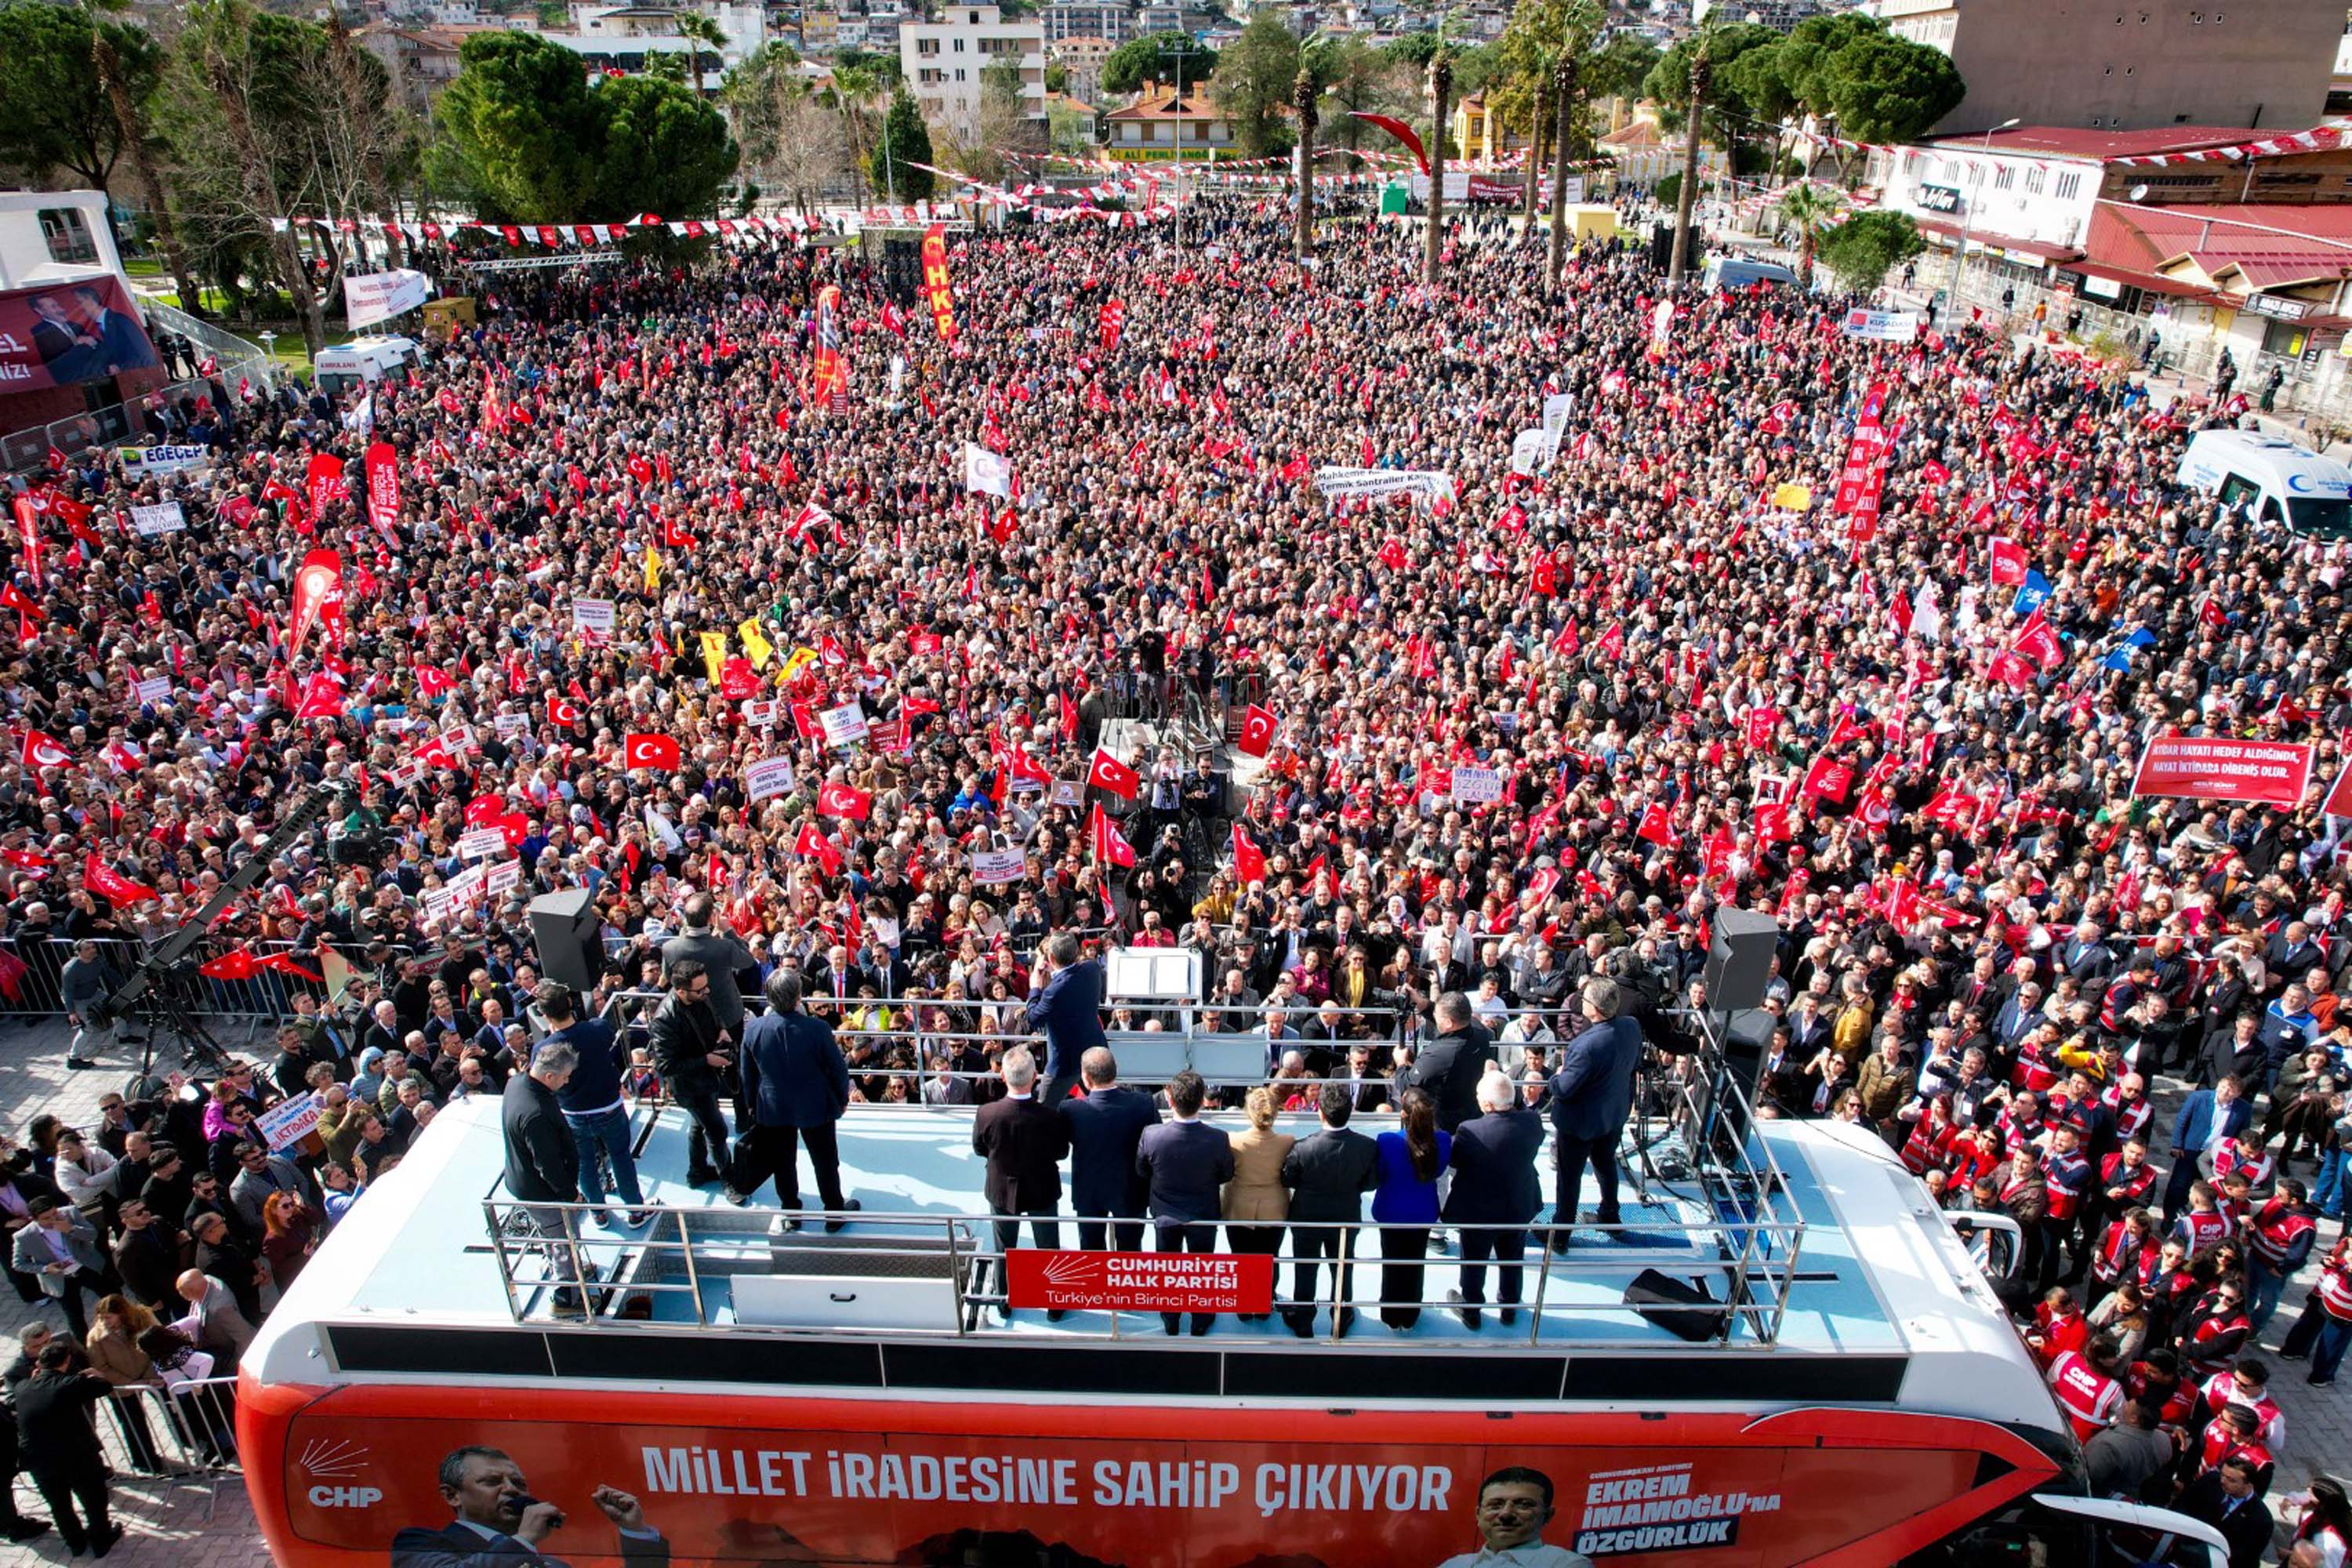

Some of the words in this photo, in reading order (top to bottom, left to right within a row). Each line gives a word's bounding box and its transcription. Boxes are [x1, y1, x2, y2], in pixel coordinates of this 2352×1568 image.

[1320, 481, 1354, 492] Termik
[1356, 475, 1405, 488] Santraller
[2152, 743, 2179, 757] İKTİDAR
[2180, 745, 2211, 757] HAYATI
[2212, 746, 2243, 758] HEDEF
[2244, 747, 2300, 764] ALDIĞINDA,
[2153, 760, 2177, 772] HAYAT
[2179, 760, 2220, 773] İKTİDARA
[2221, 762, 2259, 777] DİRENİŞ
[2261, 764, 2289, 778] OLUR.
[2200, 1224, 2222, 1234] CHP
[1106, 1257, 1239, 1273] CUMHURİYET
[1107, 1274, 1158, 1288] HALK
[1163, 1273, 1238, 1290] PARTİSİ
[1045, 1290, 1131, 1307] Türkiye'nin
[1135, 1293, 1184, 1308] Birinci
[1188, 1294, 1237, 1308] Partisi
[2070, 1367, 2098, 1387] CHP
[641, 1446, 811, 1497] MİLLET
[827, 1450, 1078, 1505] İRADESİNE
[1093, 1460, 1240, 1508] SAHİP
[1254, 1463, 1453, 1517] ÇIKIYOR
[1586, 1473, 1691, 1505] EKREM
[308, 1485, 383, 1508] CHP
[1582, 1492, 1781, 1530] İMAMOĞLU'NA
[1577, 1519, 1731, 1555] ÖZGÜRLÜK
